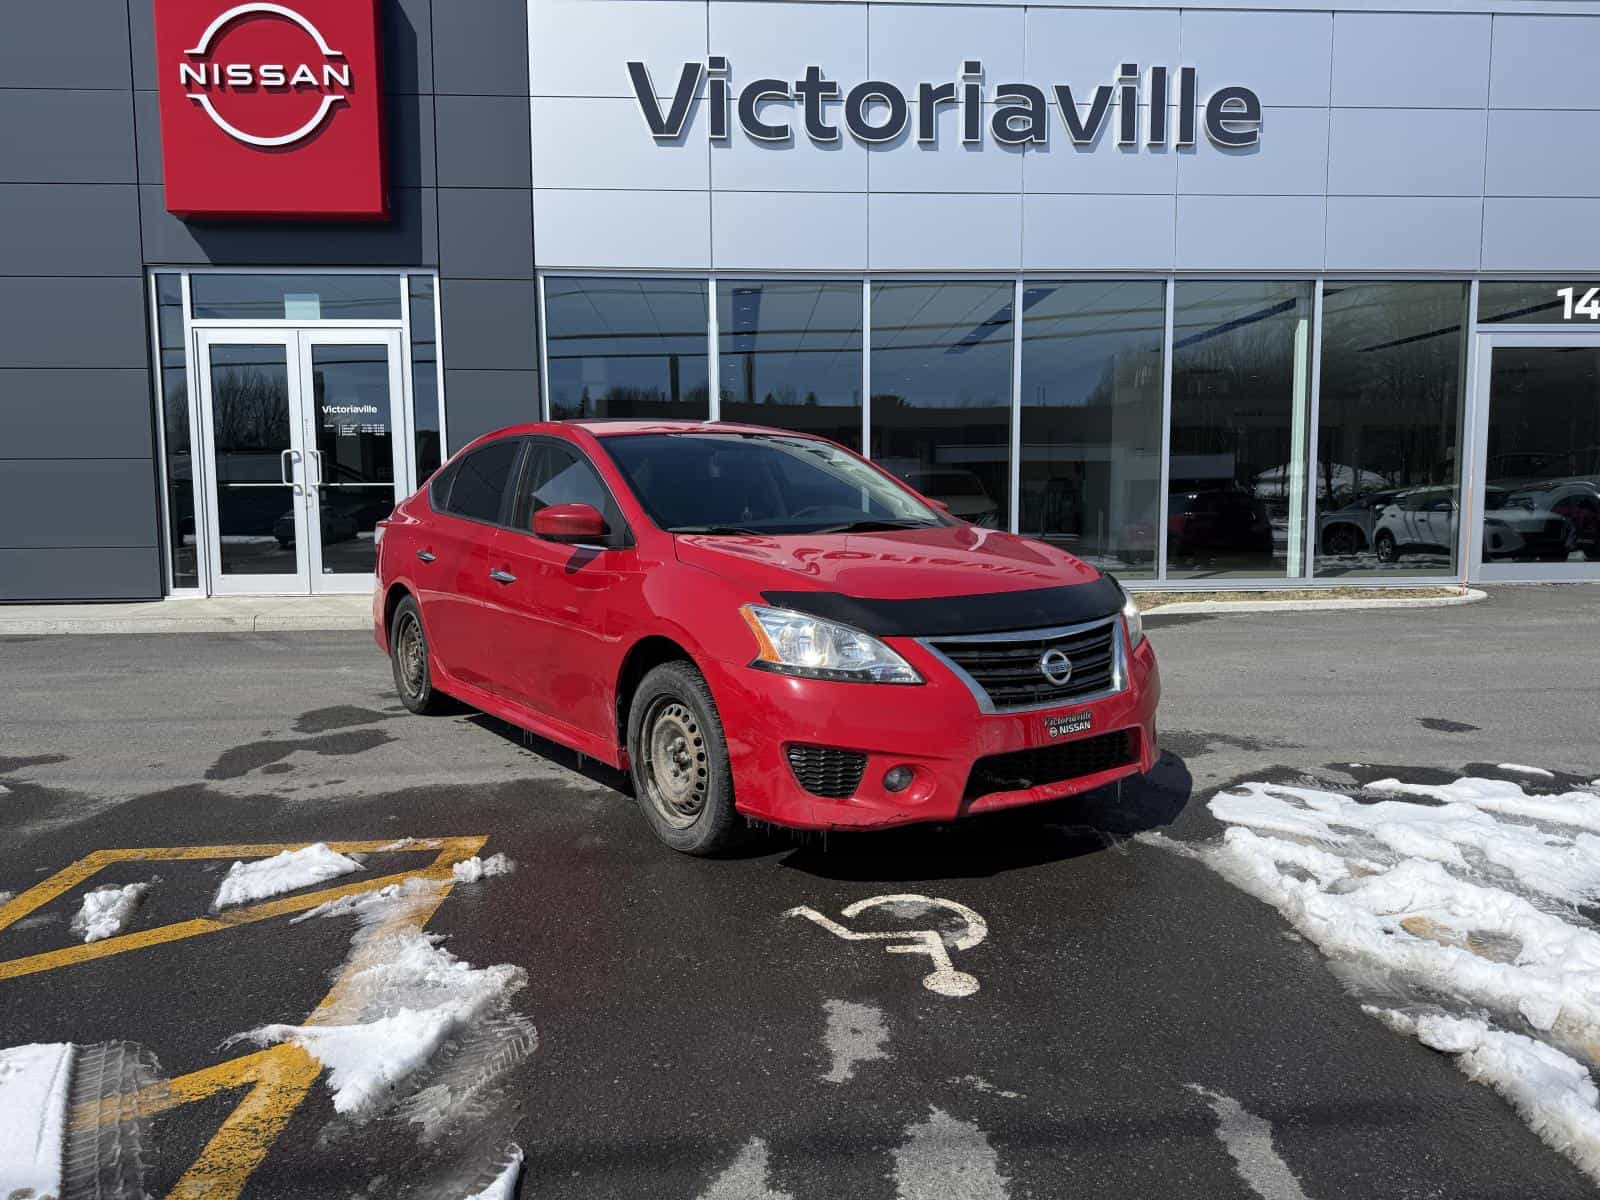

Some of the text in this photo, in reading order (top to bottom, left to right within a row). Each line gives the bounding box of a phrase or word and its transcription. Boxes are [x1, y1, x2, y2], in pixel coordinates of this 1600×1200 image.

[179, 62, 350, 87] NISSAN
[626, 56, 1263, 146] Victoriaville
[1556, 287, 1600, 320] 14
[321, 404, 378, 414] Victoriaville
[1059, 720, 1091, 734] NISSAN
